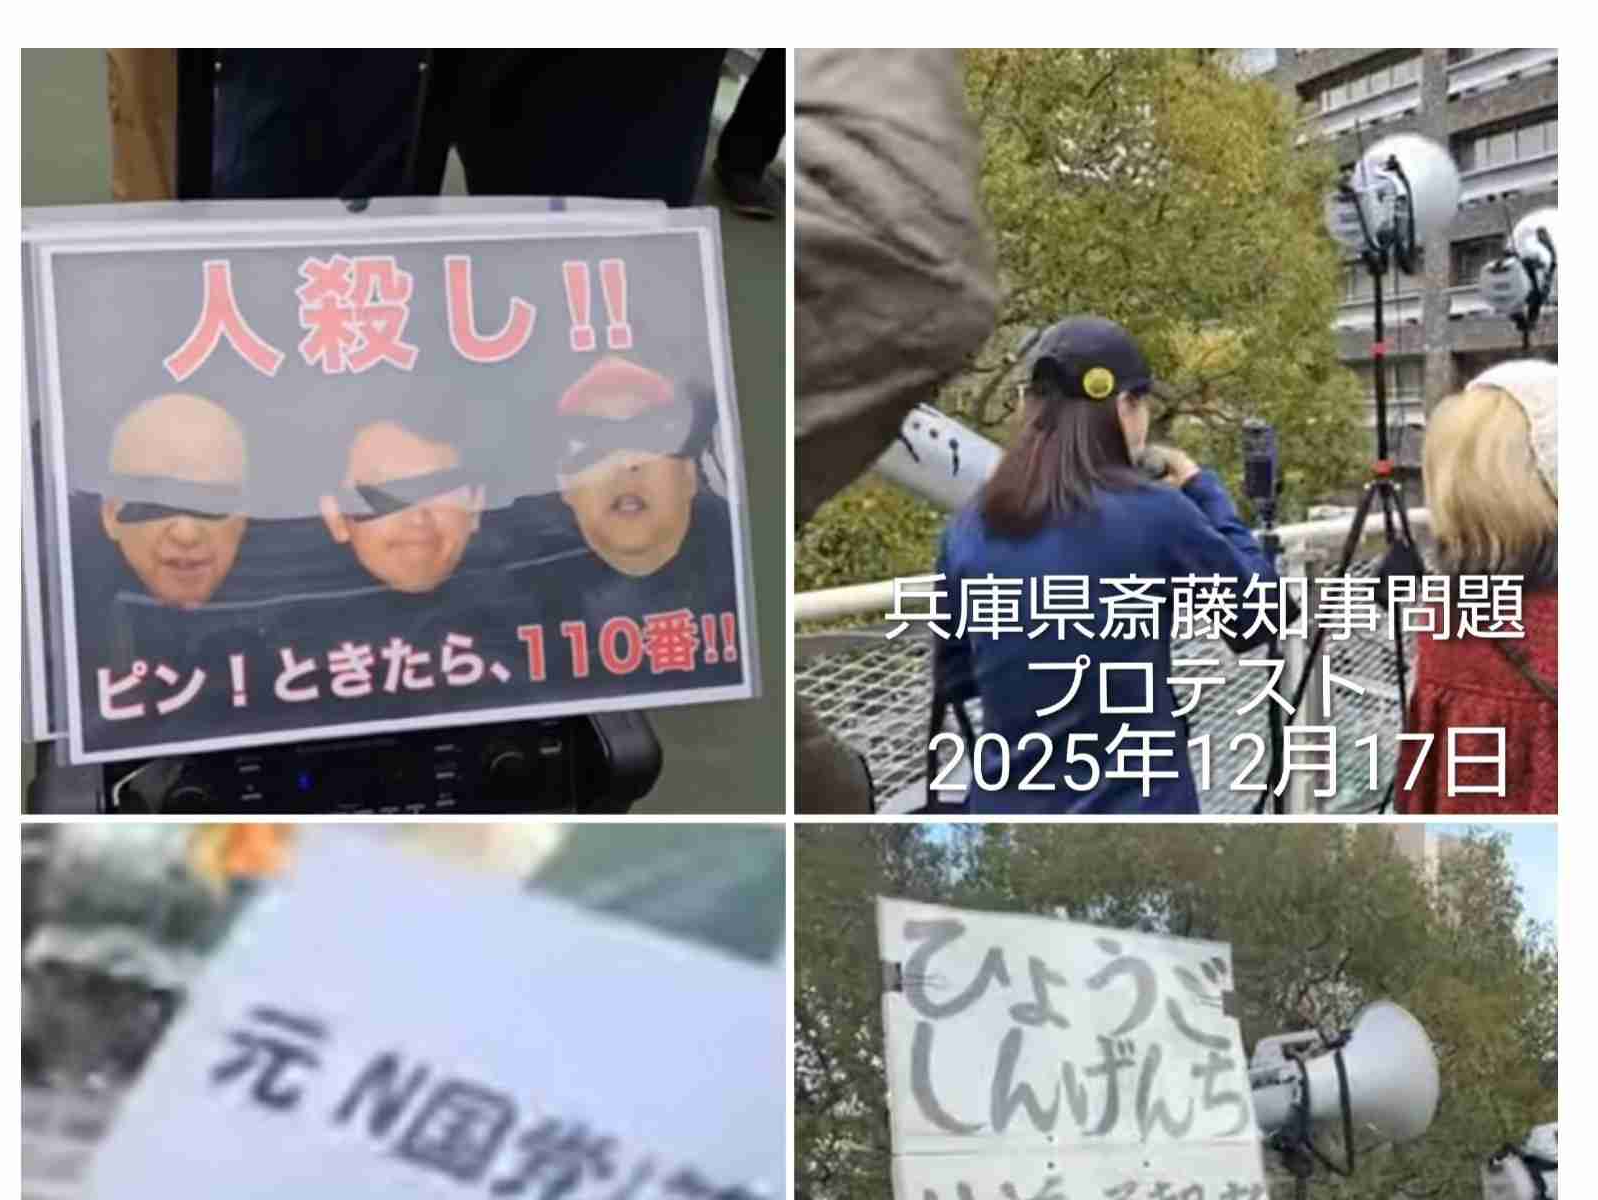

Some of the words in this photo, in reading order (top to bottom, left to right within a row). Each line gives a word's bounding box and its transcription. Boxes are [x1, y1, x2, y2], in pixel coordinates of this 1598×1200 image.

[902, 918, 1233, 1052] ひょうご
[208, 1003, 332, 1112] 元
[910, 1019, 1251, 1138] しんげんち
